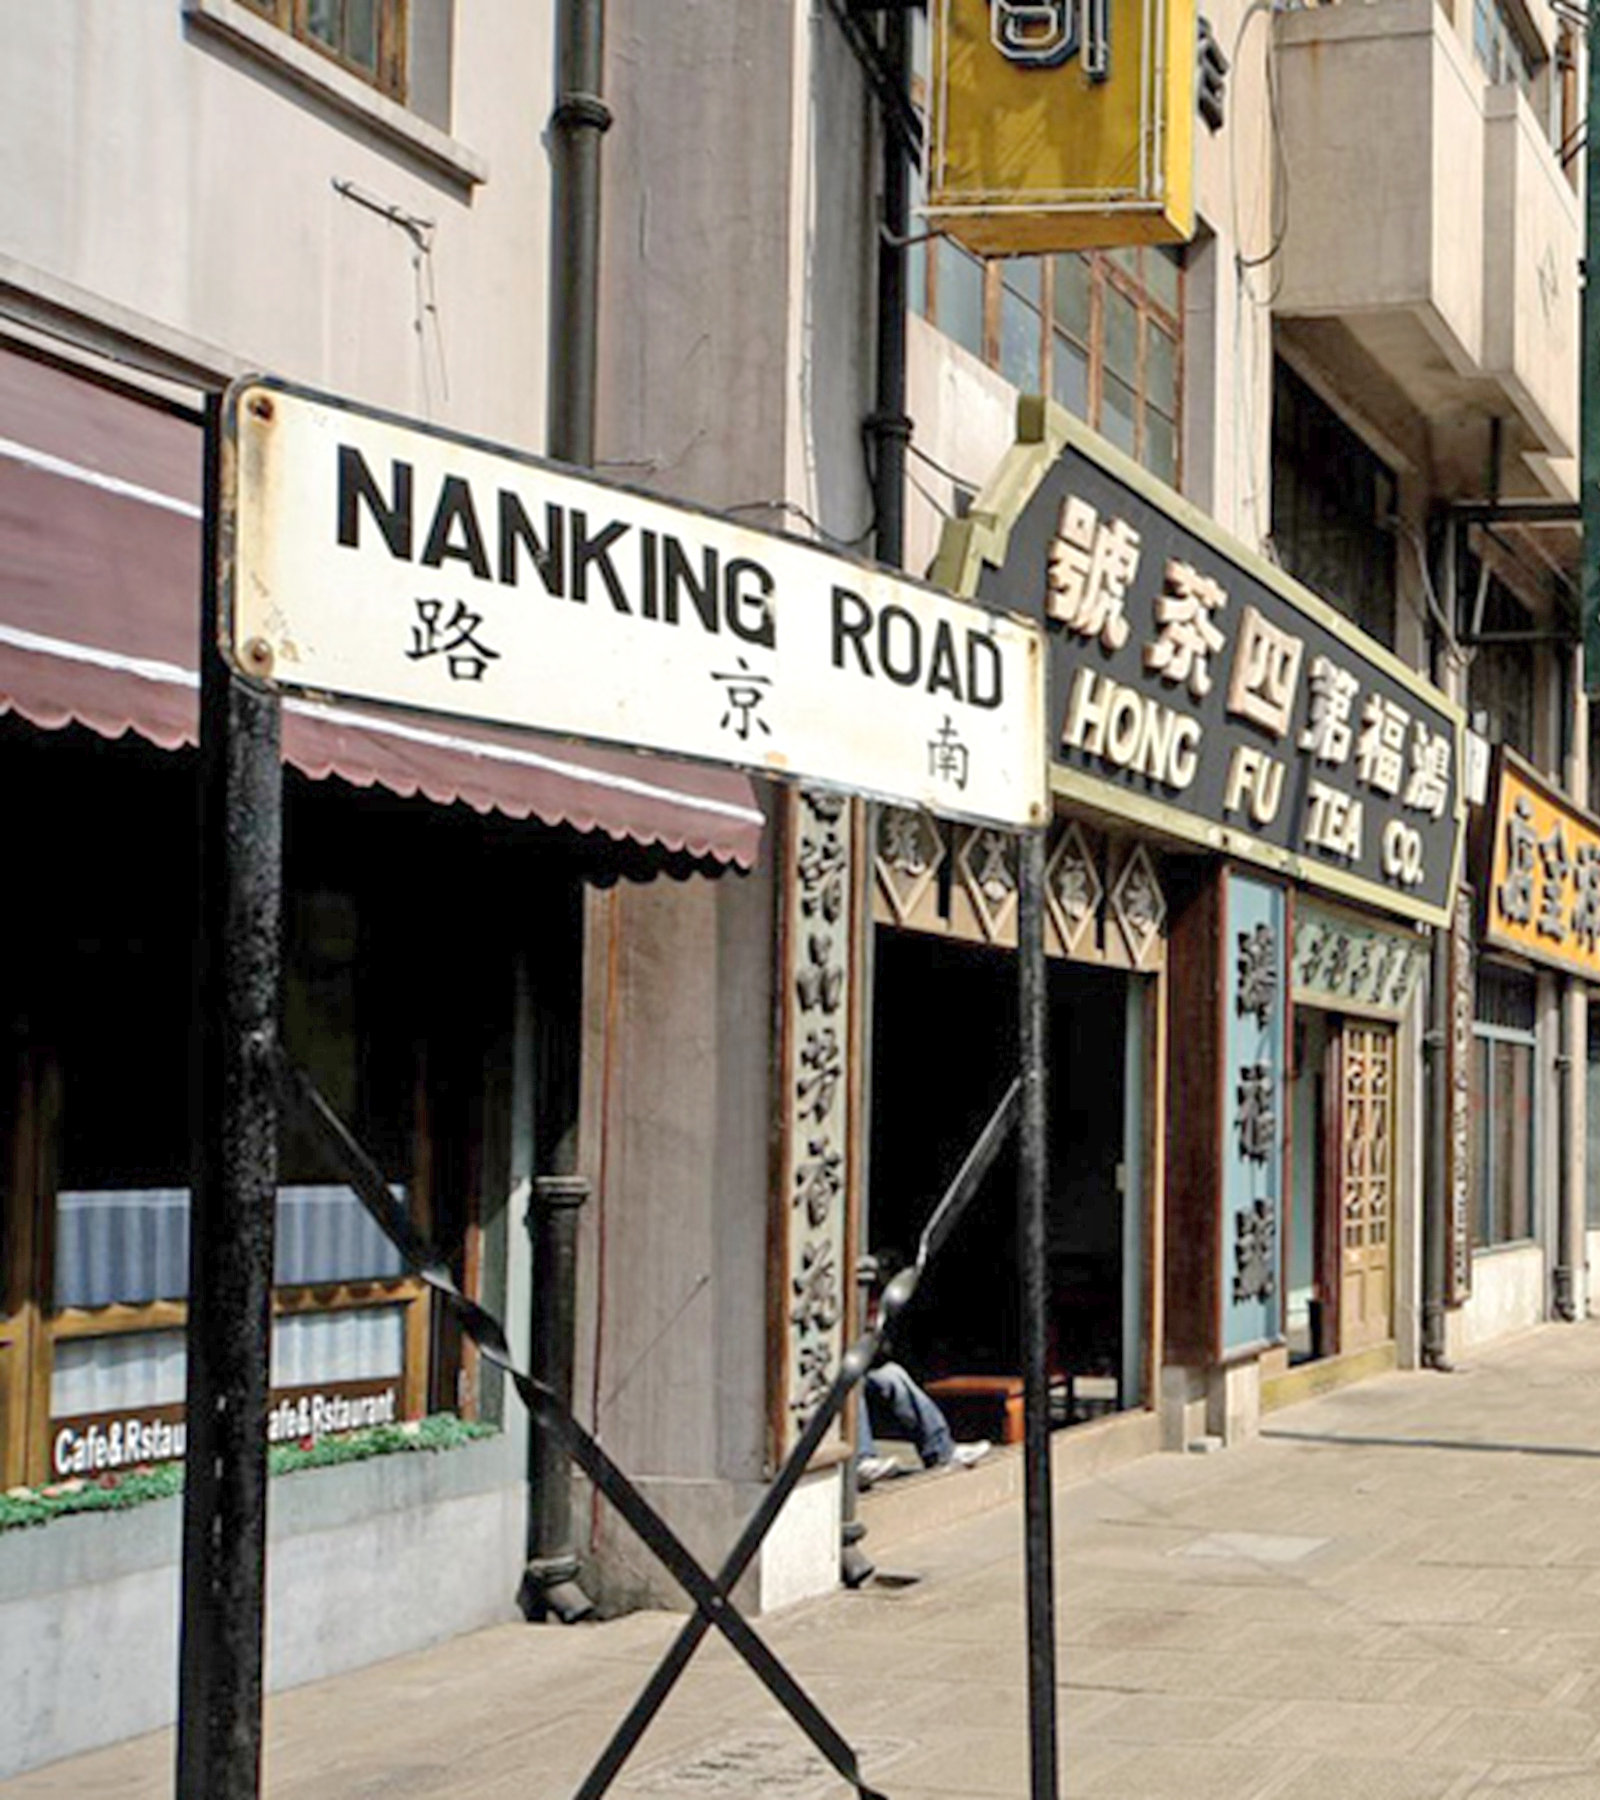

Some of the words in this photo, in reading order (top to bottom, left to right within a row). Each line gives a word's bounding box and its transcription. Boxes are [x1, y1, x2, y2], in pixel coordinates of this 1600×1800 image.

[335, 442, 778, 650] NANKING
[830, 584, 1004, 711] ROAD
[1061, 666, 1202, 791] HONG
[1224, 744, 1287, 826] FU
[1302, 781, 1366, 863] TEA
[1381, 819, 1425, 887] CO.
[53, 1417, 187, 1475] Cafe&Rstau
[268, 1387, 396, 1442] afe&Rstaurant
